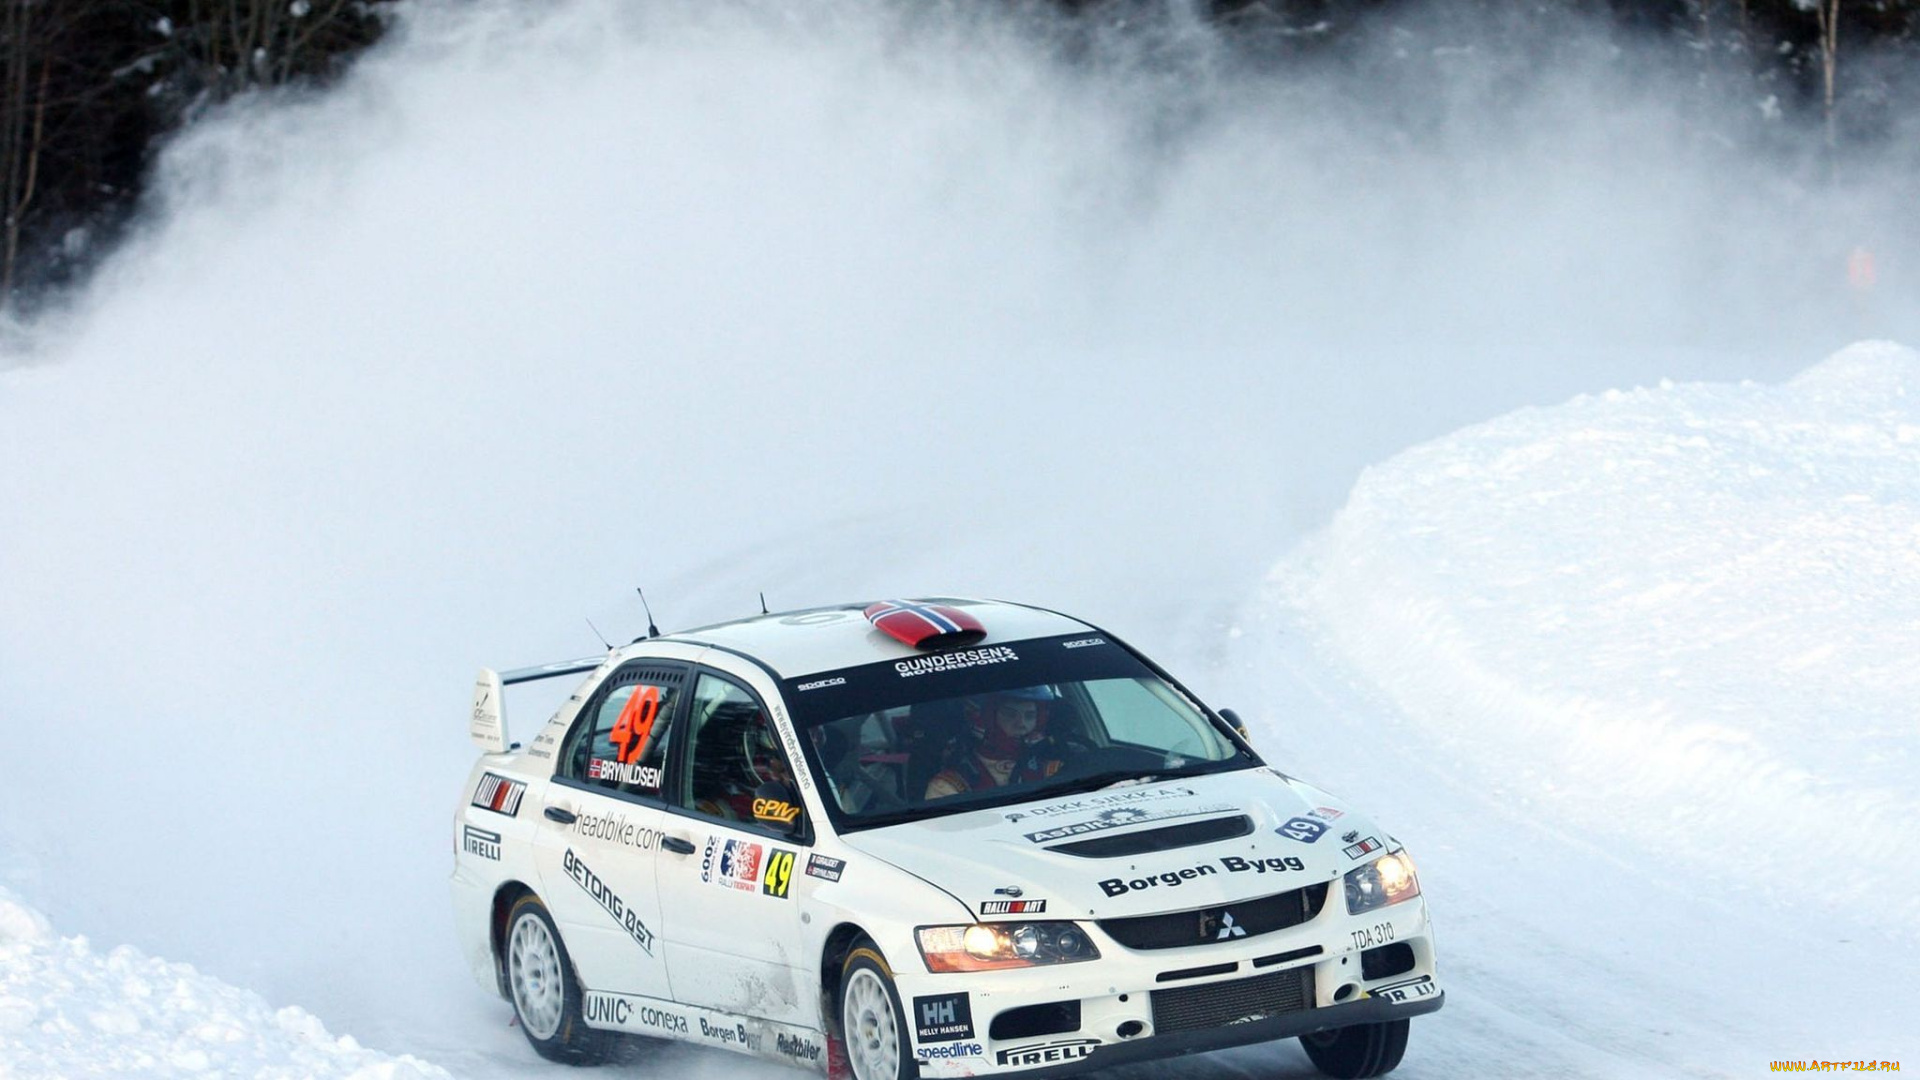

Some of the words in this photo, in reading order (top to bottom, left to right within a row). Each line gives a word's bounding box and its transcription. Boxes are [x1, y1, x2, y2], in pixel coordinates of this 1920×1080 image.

[895, 648, 1003, 673] GUNDERSEN
[797, 677, 846, 690] sparco
[609, 684, 660, 766] 49
[600, 760, 661, 789] BRYNILDSEN
[1031, 801, 1083, 816] DEKK
[573, 806, 666, 852] headbike.com
[1034, 820, 1105, 842] Asfalt
[1284, 821, 1320, 841] 49
[464, 825, 501, 861] PIRELLI
[701, 835, 716, 883] 2009
[765, 851, 793, 897] 49
[1098, 863, 1218, 898] Borgen
[1220, 856, 1305, 873] Bygg
[563, 848, 624, 918] BETONG
[624, 908, 655, 951] ØST
[1351, 928, 1374, 950] TDA
[1376, 921, 1395, 943] 310
[641, 1006, 689, 1033] conexa
[922, 1000, 955, 1026] HH
[700, 1017, 736, 1043] Borgen
[919, 1026, 939, 1037] HELLY
[940, 1024, 969, 1034] HANSEN
[917, 1042, 982, 1059] speedline
[996, 1038, 1102, 1066] PIRELL
